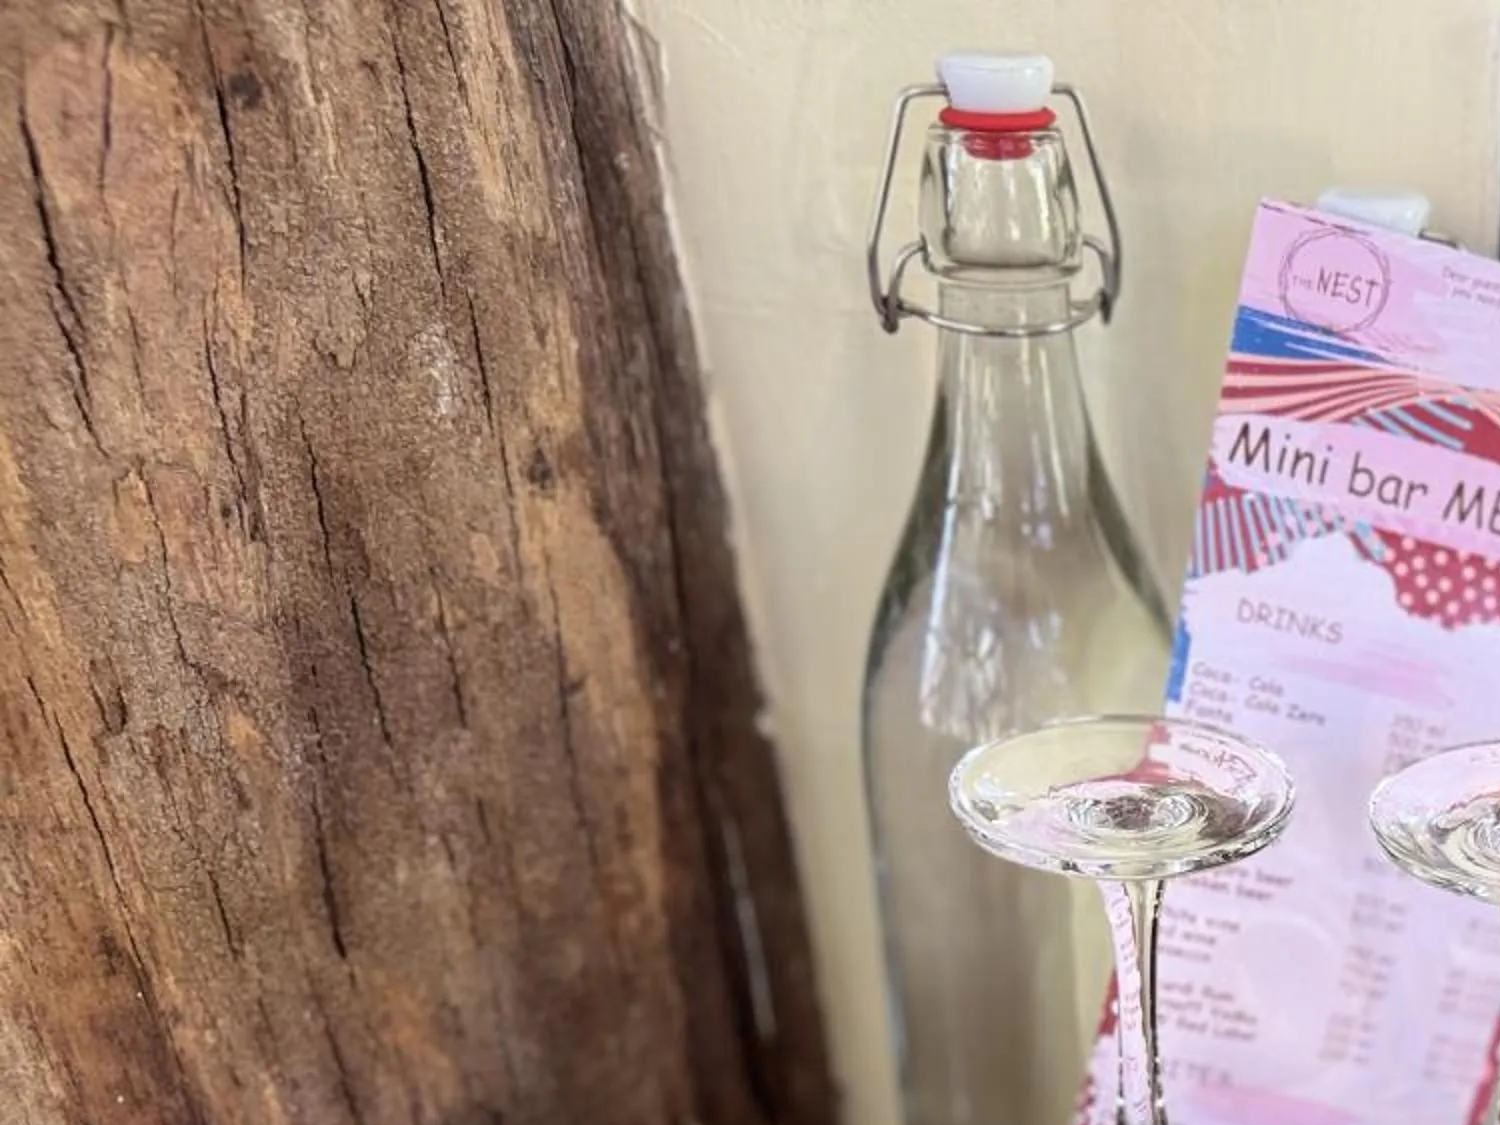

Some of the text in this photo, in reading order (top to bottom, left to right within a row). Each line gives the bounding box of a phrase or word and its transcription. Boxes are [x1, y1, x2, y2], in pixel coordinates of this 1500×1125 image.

[1317, 266, 1380, 307] NEST
[1228, 421, 1336, 485] Mini
[1348, 451, 1429, 511] bar
[1236, 596, 1345, 645] DRINKS
[1249, 676, 1284, 697] Cola
[1244, 693, 1281, 715] Cola
[1286, 703, 1327, 725] Zero
